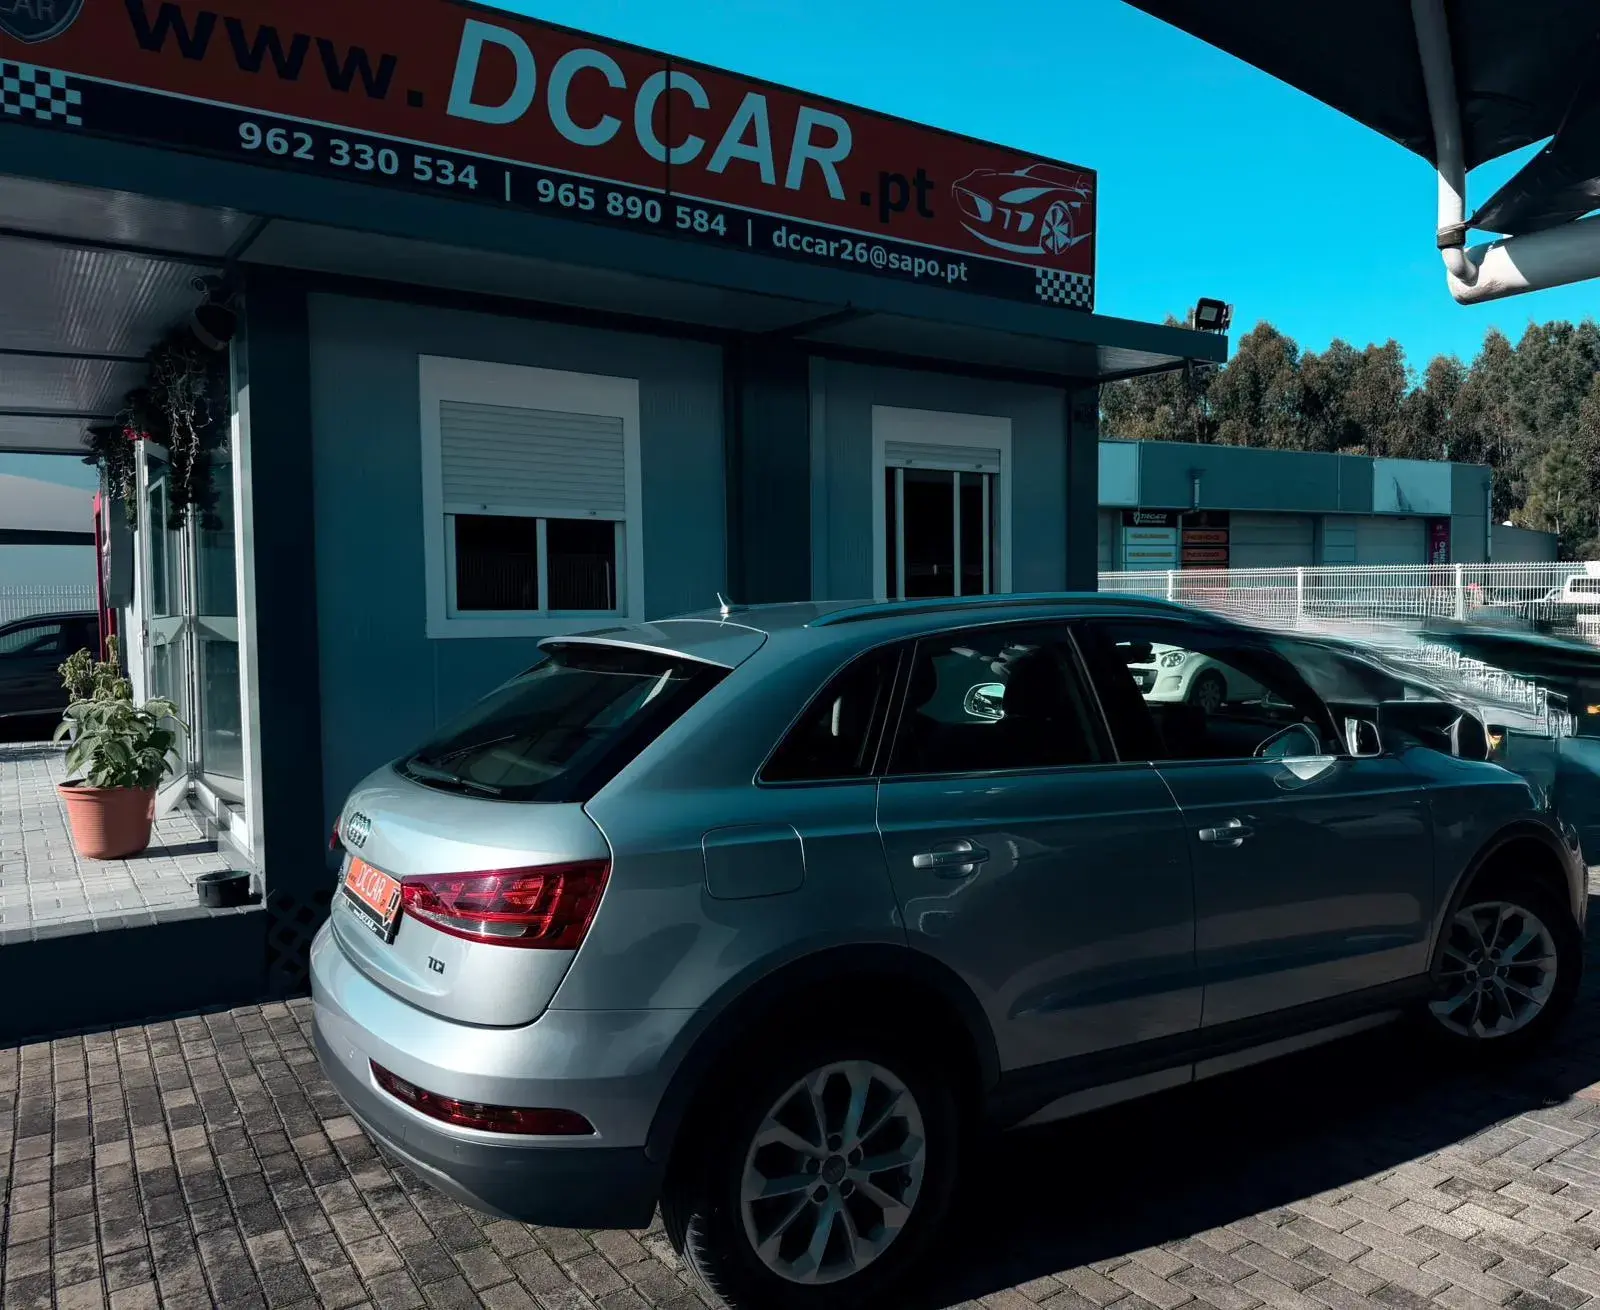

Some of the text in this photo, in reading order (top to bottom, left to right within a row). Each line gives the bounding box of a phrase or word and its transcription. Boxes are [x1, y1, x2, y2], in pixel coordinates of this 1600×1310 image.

[238, 122, 314, 161] 962
[329, 138, 399, 175] 330
[413, 154, 478, 190] 534
[537, 178, 595, 211] 965
[606, 191, 662, 223] 890
[676, 205, 727, 236] 584
[772, 225, 968, 284] dccar26@sapo.pt
